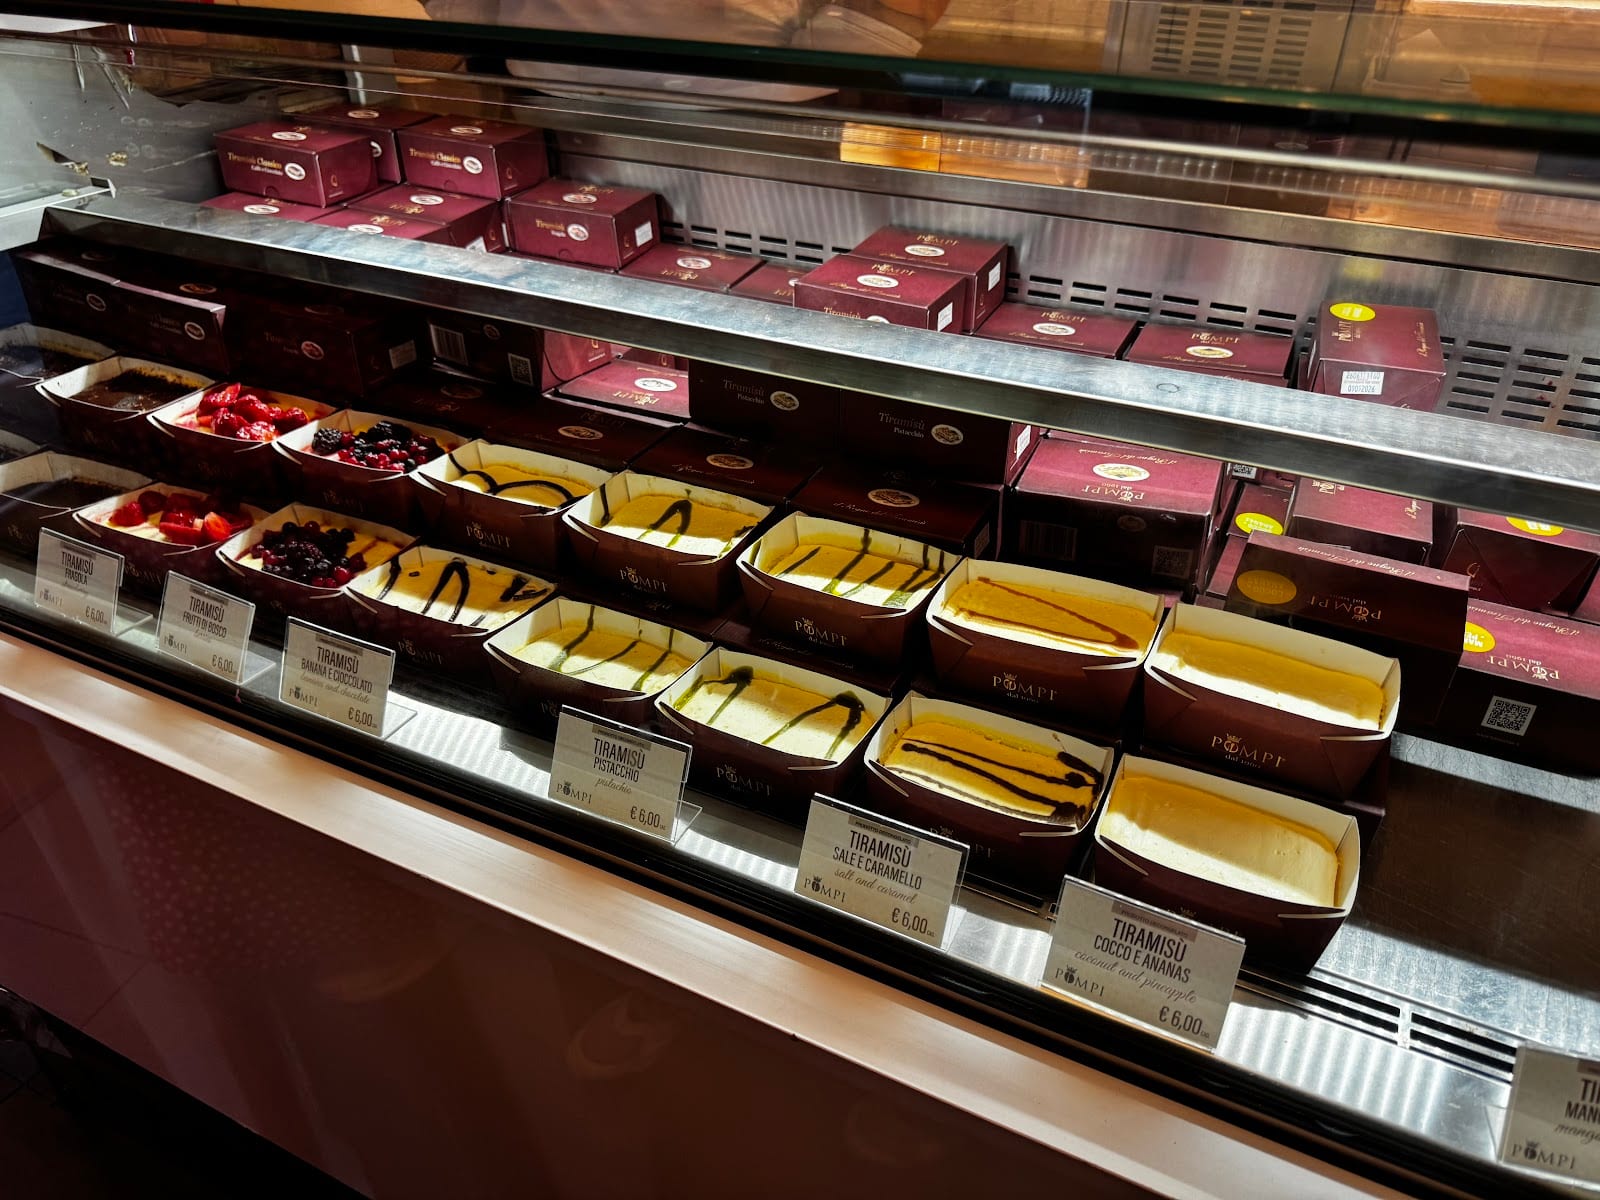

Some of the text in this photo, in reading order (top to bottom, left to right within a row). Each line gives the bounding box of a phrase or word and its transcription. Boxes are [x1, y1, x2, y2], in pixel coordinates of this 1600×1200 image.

[1082, 485, 1145, 502] POMPI
[62, 551, 94, 576] TIRAMISÙ
[189, 595, 225, 623] TIRAMISÙ
[1309, 595, 1382, 622] POMPI
[182, 611, 201, 628] FRUTTI
[208, 621, 227, 639] BOSCO
[795, 617, 848, 647] POMPI
[317, 646, 359, 674] TIRAMISÙ
[1488, 656, 1560, 681] POMPI
[301, 658, 327, 679] BANANA
[333, 669, 373, 694] CIOCCOLATO
[993, 673, 1058, 701] POMPI
[594, 737, 646, 770] TIRAMISÙ
[1211, 733, 1286, 768] POMPI
[593, 756, 640, 783] PISTACCHIO
[556, 782, 592, 804] POMPI
[595, 776, 633, 795] pistachio
[850, 830, 912, 868] TIRAMISÙ
[832, 846, 922, 890] SALE E CARAMELLO
[804, 876, 846, 903] POMPI
[834, 867, 919, 905] salt and caramel
[1112, 917, 1188, 963] TIRAMISÙ
[1093, 934, 1191, 984] COCCO E ANANAS
[1055, 965, 1105, 997] POMPI
[1074, 951, 1197, 1004] coconut and pineapple
[1512, 1140, 1576, 1169] POMPI
